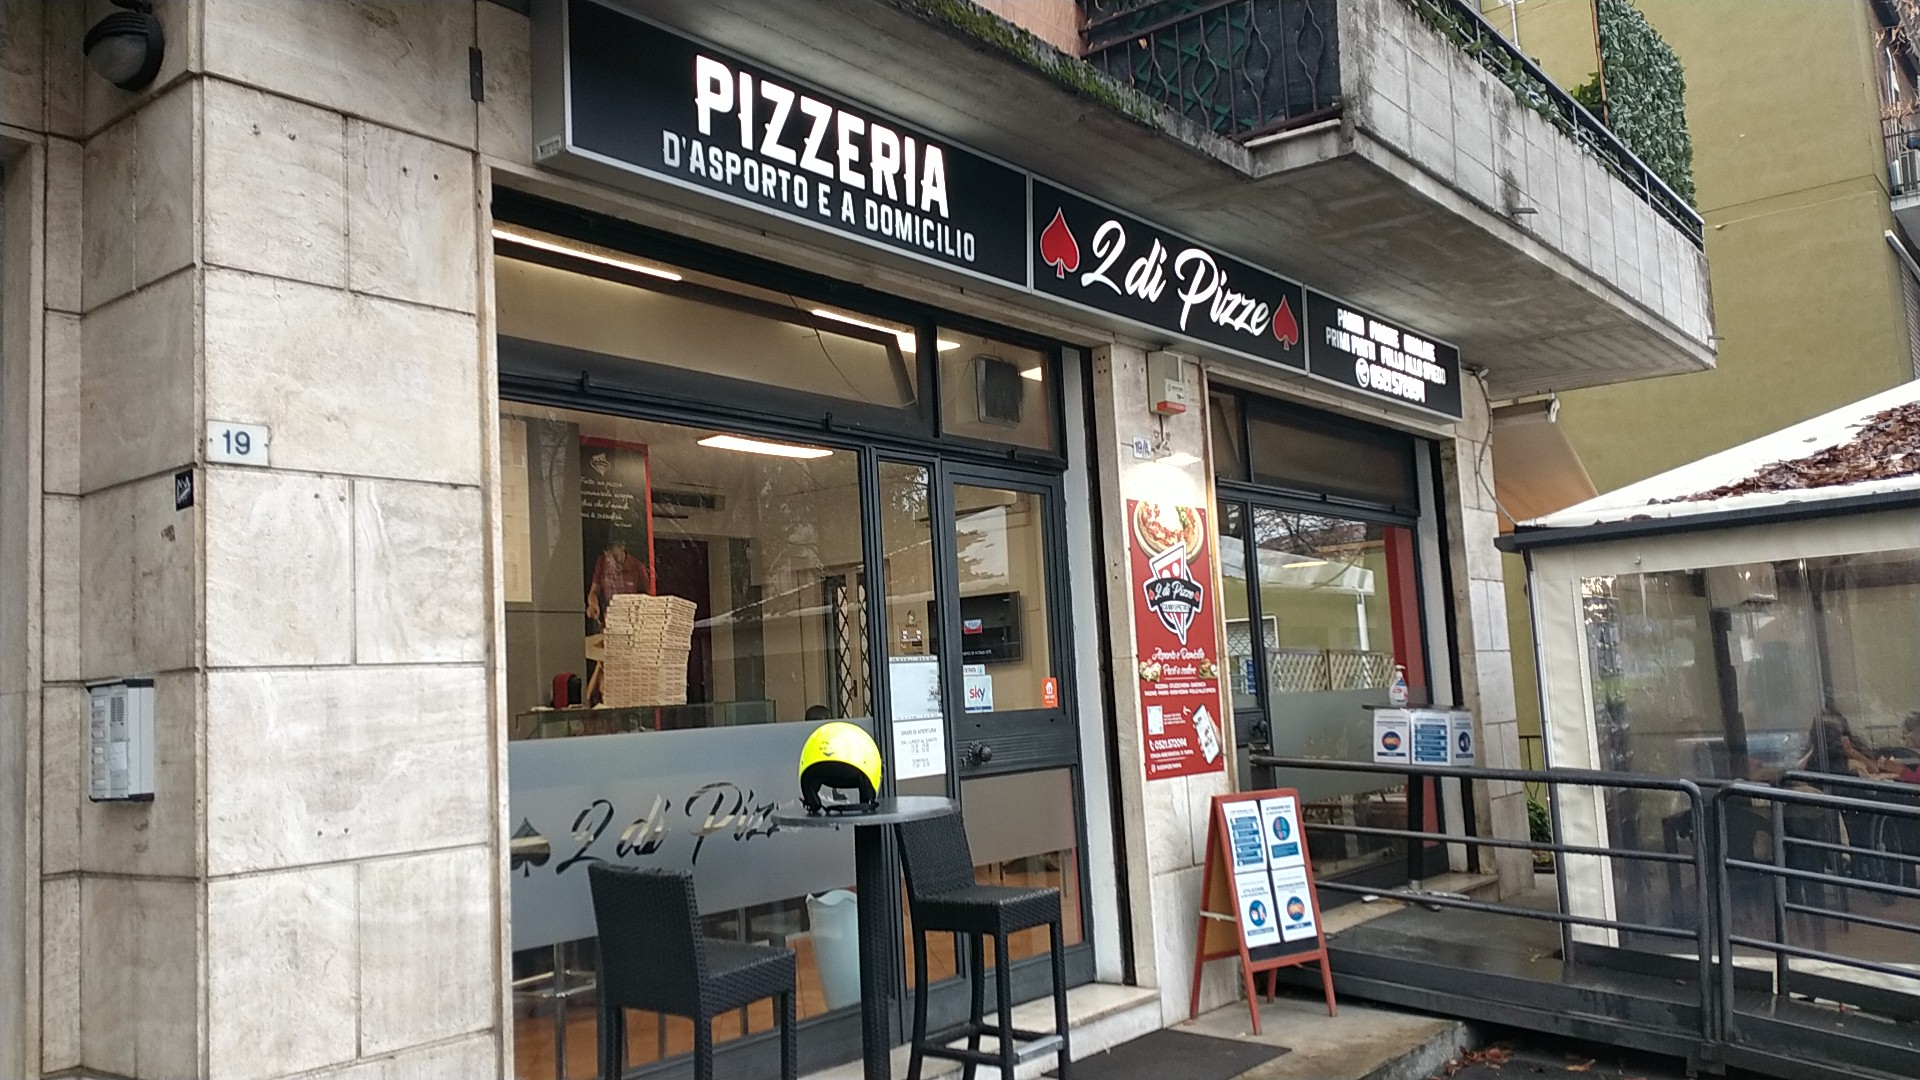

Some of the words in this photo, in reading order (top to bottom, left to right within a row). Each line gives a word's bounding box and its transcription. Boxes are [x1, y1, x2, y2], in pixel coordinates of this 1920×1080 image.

[695, 55, 949, 219] PIZZERIA
[662, 129, 808, 211] D'ASPORTO
[818, 182, 831, 217] E
[842, 191, 856, 226] A
[865, 198, 976, 263] DOMICILIO
[1081, 220, 1125, 296] 2
[1125, 238, 1167, 303] di
[1174, 248, 1271, 336] Pizze
[222, 429, 251, 456] 19
[1134, 440, 1150, 456] 19/A
[969, 685, 986, 702] sky
[555, 799, 614, 875] 2
[616, 794, 671, 858] di
